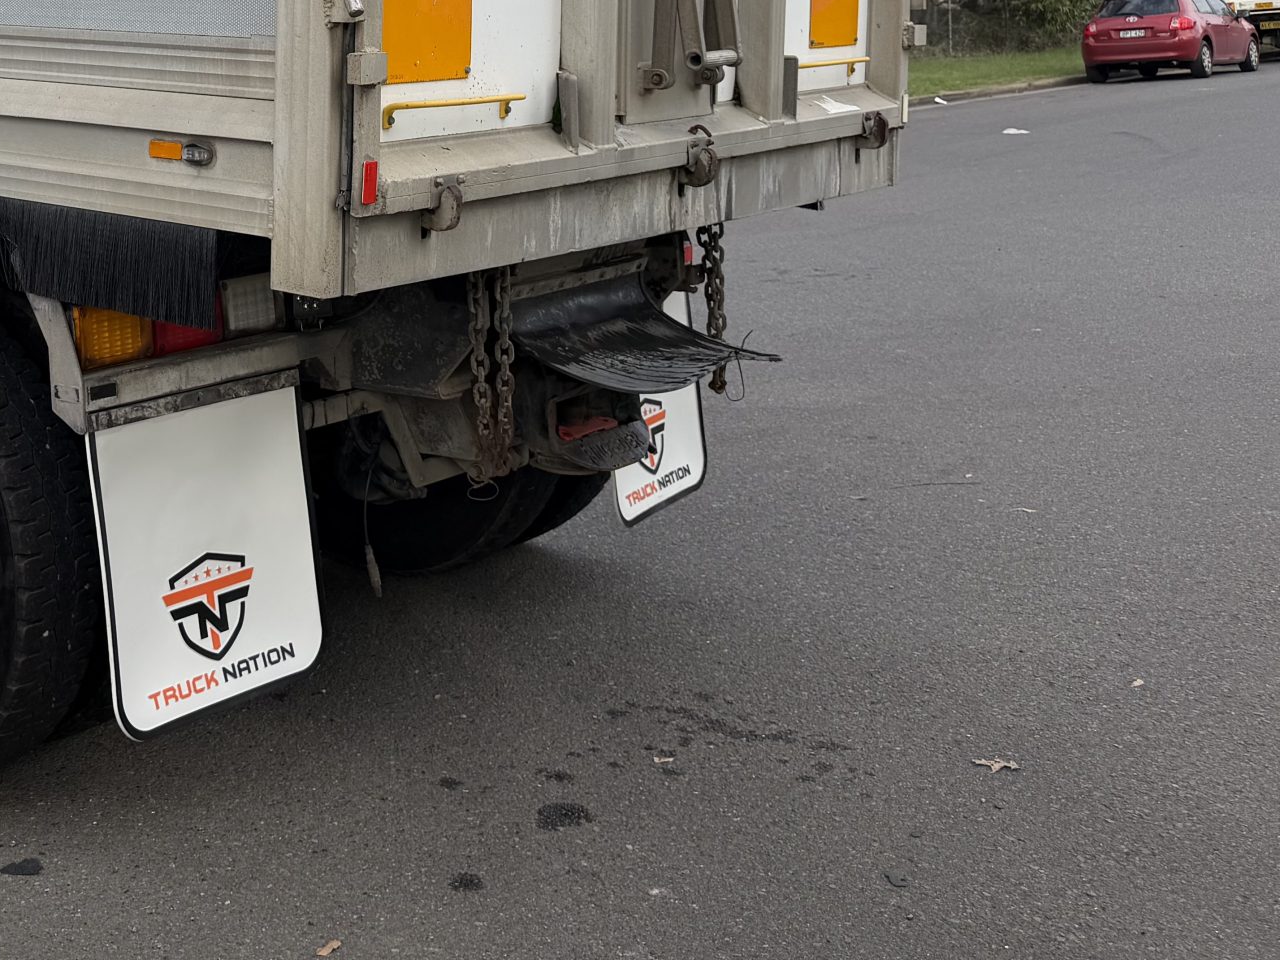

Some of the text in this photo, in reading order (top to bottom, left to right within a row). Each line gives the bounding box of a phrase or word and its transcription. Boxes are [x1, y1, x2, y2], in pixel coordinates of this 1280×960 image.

[625, 464, 692, 507] TRUCK NATION
[147, 642, 296, 711] TRUCK NATION
